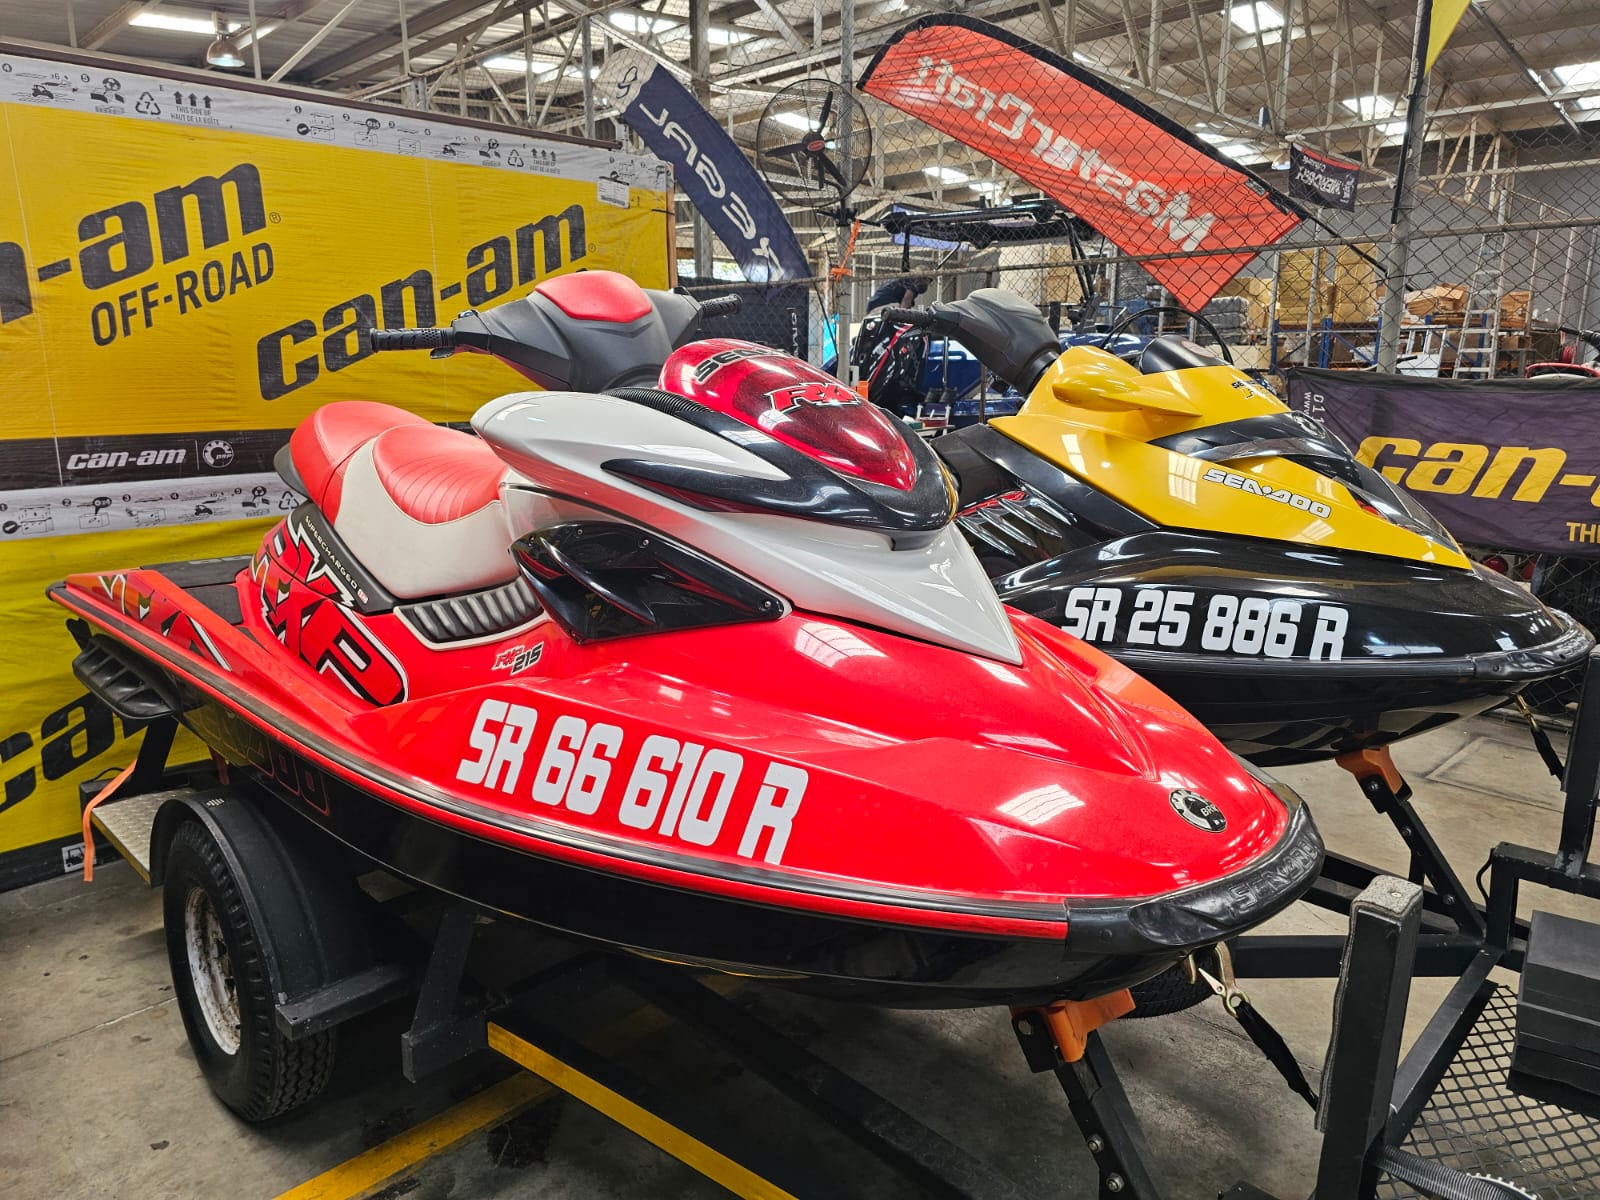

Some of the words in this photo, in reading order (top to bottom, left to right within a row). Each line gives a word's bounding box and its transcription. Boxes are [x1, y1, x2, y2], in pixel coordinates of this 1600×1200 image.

[91, 242, 274, 346] OFF-ROAD
[257, 204, 586, 401] can-am
[66, 449, 186, 470] can-am
[1354, 436, 1600, 507] can-
[304, 515, 358, 589] SUPERCHARGED
[1566, 521, 1600, 544] TH
[510, 641, 544, 676] 215
[1061, 587, 1122, 643] SR
[1127, 589, 1195, 647] 25
[1201, 594, 1302, 658] 886
[1309, 605, 1349, 661] R
[455, 698, 538, 794] SR
[532, 715, 624, 815] 66
[618, 734, 744, 846] 610
[737, 761, 809, 865] R
[1200, 804, 1220, 816] BRP
